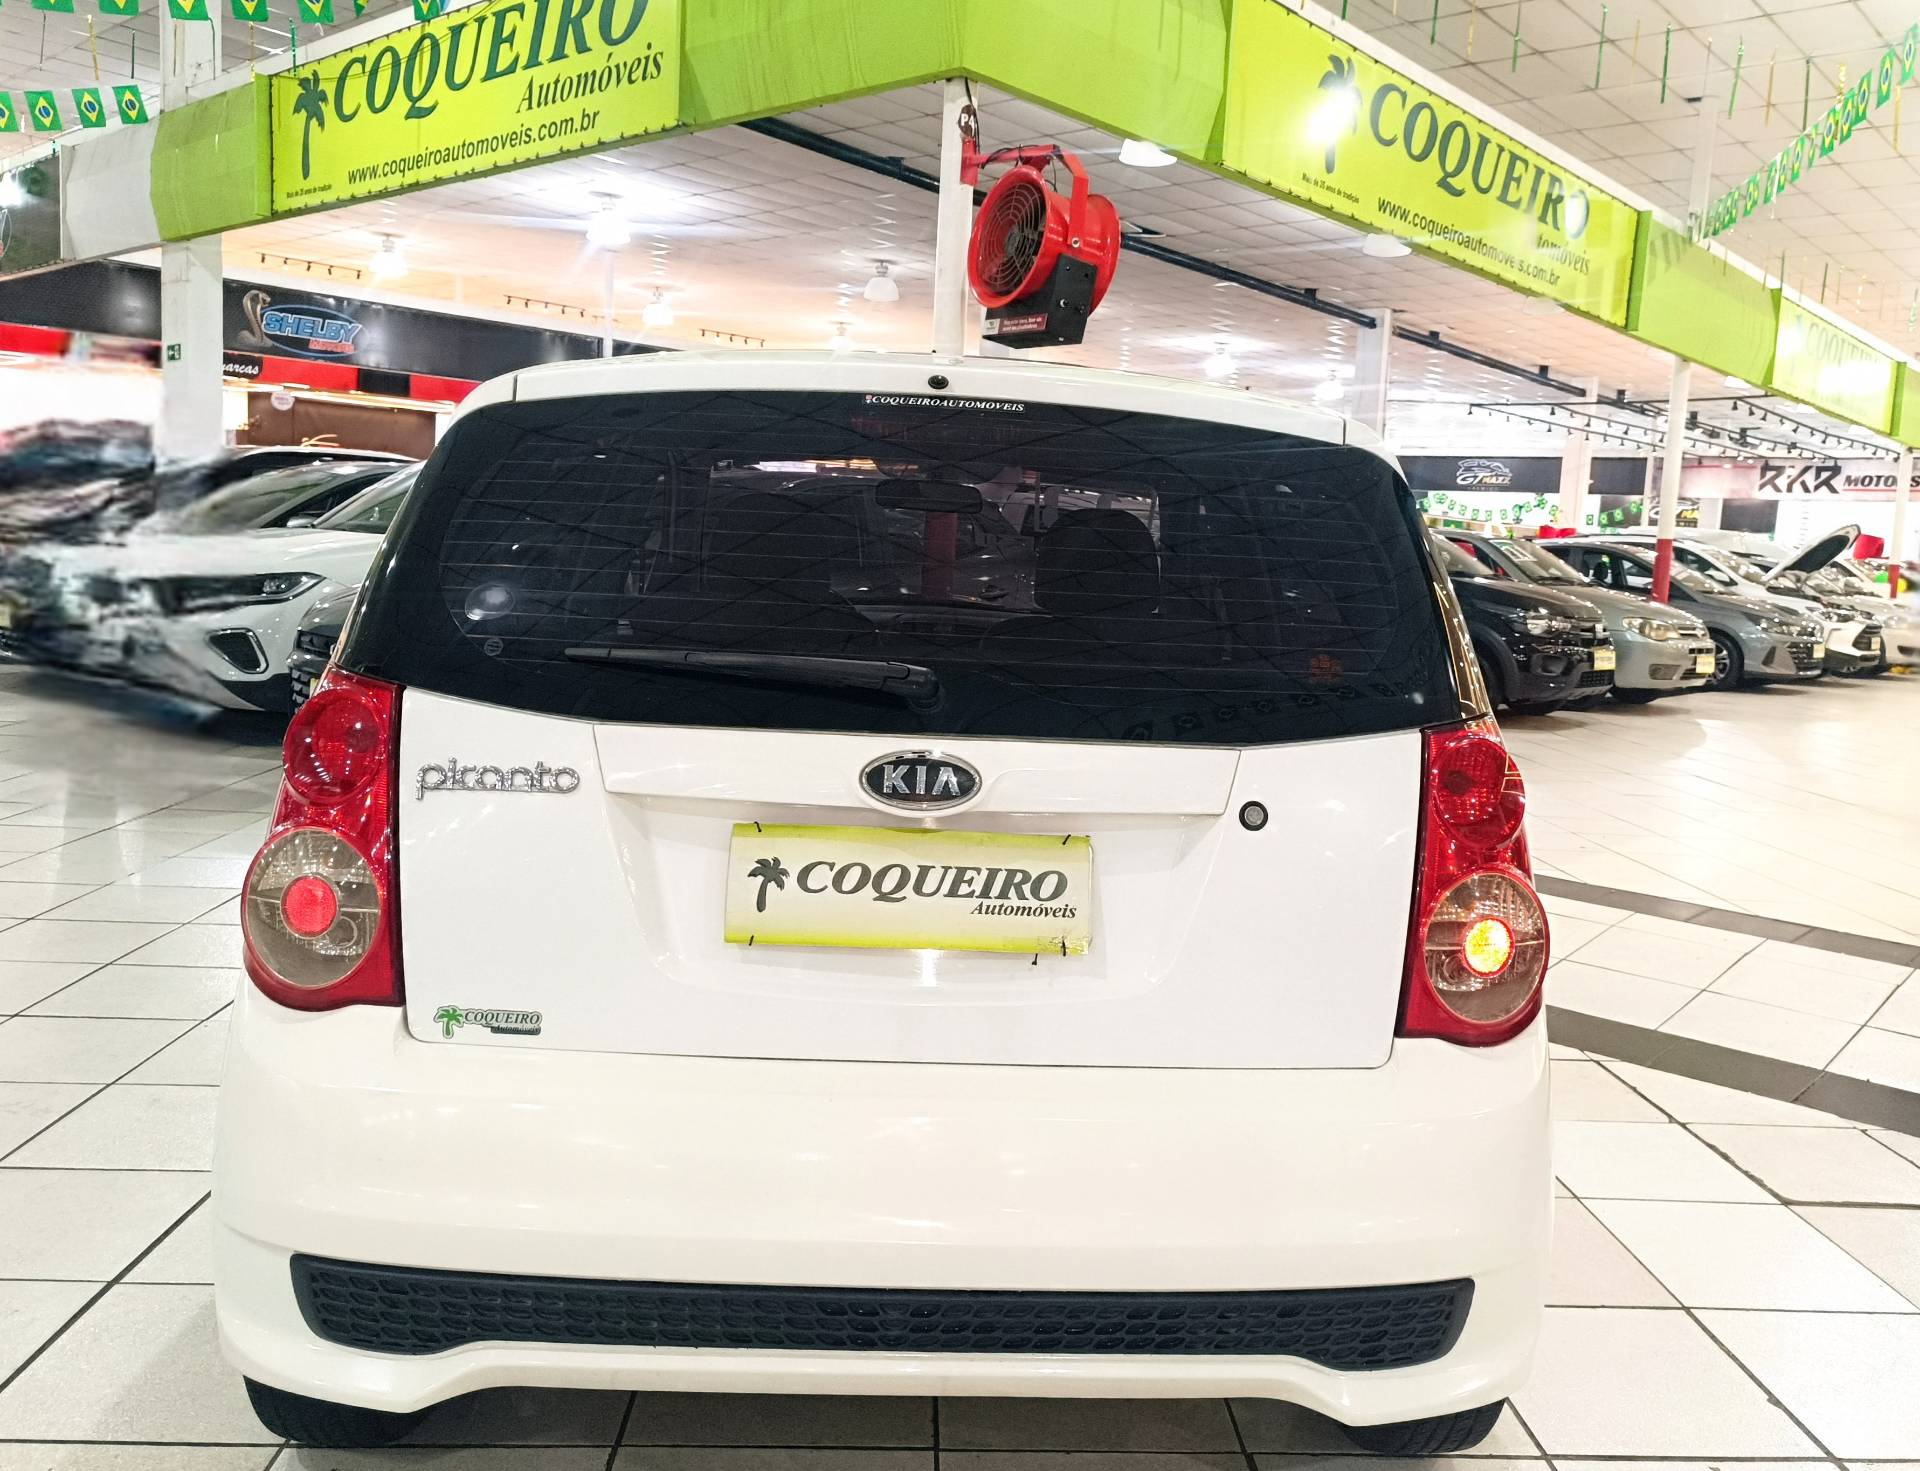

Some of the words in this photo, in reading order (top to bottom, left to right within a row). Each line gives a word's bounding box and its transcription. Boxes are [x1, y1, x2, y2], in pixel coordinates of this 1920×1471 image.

[333, 0, 648, 121] COQUEIRO
[516, 41, 664, 114] Automóveis
[347, 108, 600, 185] www.coqueiroautomoveis.com.br
[1378, 196, 1561, 286] www.coqueiroautomoves.com.br
[261, 311, 362, 343] SHELBY
[872, 395, 1025, 412] COQUEIROAUTOMOVEIS
[1758, 465, 1842, 494] RKR
[1843, 475, 1920, 488] MOTOS
[415, 757, 580, 800] picanto
[882, 764, 961, 796] KIA
[796, 860, 1068, 903] COQUEIRO
[970, 900, 1077, 919] Automóveis
[464, 1011, 540, 1026] COQUEIRO
